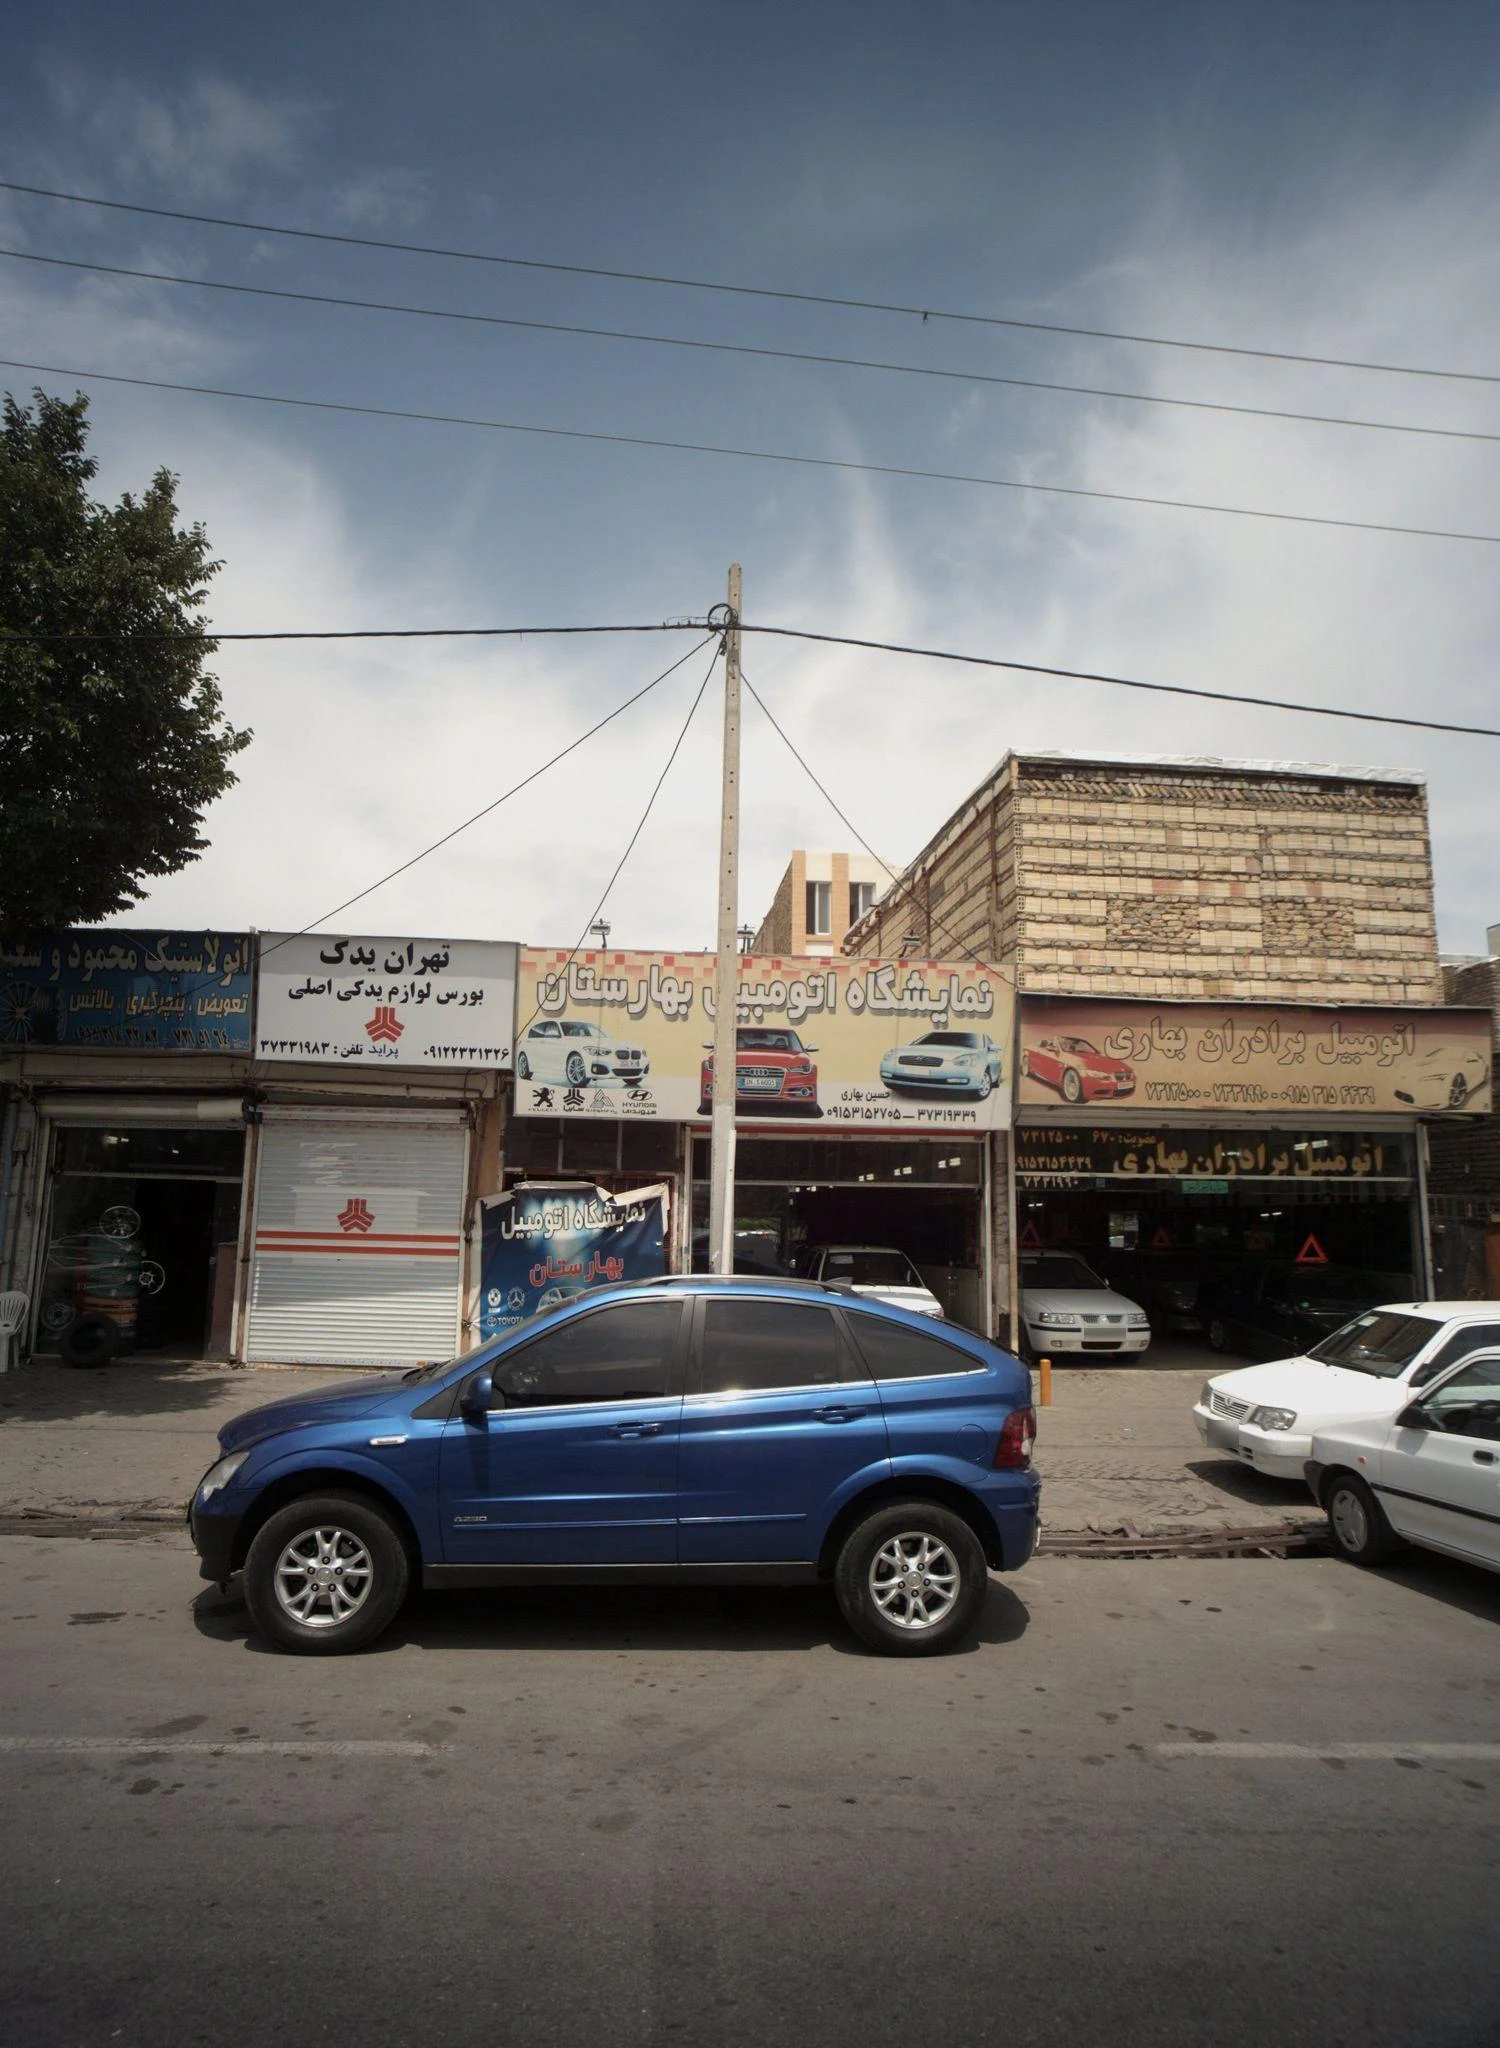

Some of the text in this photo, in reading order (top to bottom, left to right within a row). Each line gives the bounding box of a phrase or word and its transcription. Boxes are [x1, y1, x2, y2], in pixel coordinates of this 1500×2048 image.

[48, 948, 61, 981] و
[68, 940, 138, 982] محمود
[320, 940, 451, 975] تهران یدک
[69, 989, 114, 1014] بالانس
[288, 977, 484, 1006] بورس لوازم یدکی اصلی
[537, 961, 694, 1016] بهارستان
[845, 964, 994, 1023] نمایشگاه
[196, 993, 249, 1018] تعویض
[261, 1039, 330, 1055] ۳۷۳۳۱۹۸۳
[368, 1044, 399, 1059] پراید
[423, 1045, 510, 1061] ۰۹۱۲۲۳۳۱۳۲۶
[1104, 1016, 1416, 1066] اتومبیل برادران بهاری
[841, 1088, 890, 1101] حسین بهاری
[1145, 1081, 1200, 1101] ۷۳۱۲۵۰۰
[1213, 1083, 1269, 1103] ۷۳۳۱۹۹۰
[827, 1106, 901, 1120] ۰۹۱۵۳۱۵۲۷۰۵
[917, 1108, 976, 1122] ۳۷۳۱۹۳۳۹
[1022, 1130, 1078, 1143] ۷۳۱۲۵۰۰
[1113, 1141, 1188, 1178] بهاری
[501, 1198, 646, 1240] نمایشگاه اتومبیل
[529, 1251, 624, 1287] بهارستان
